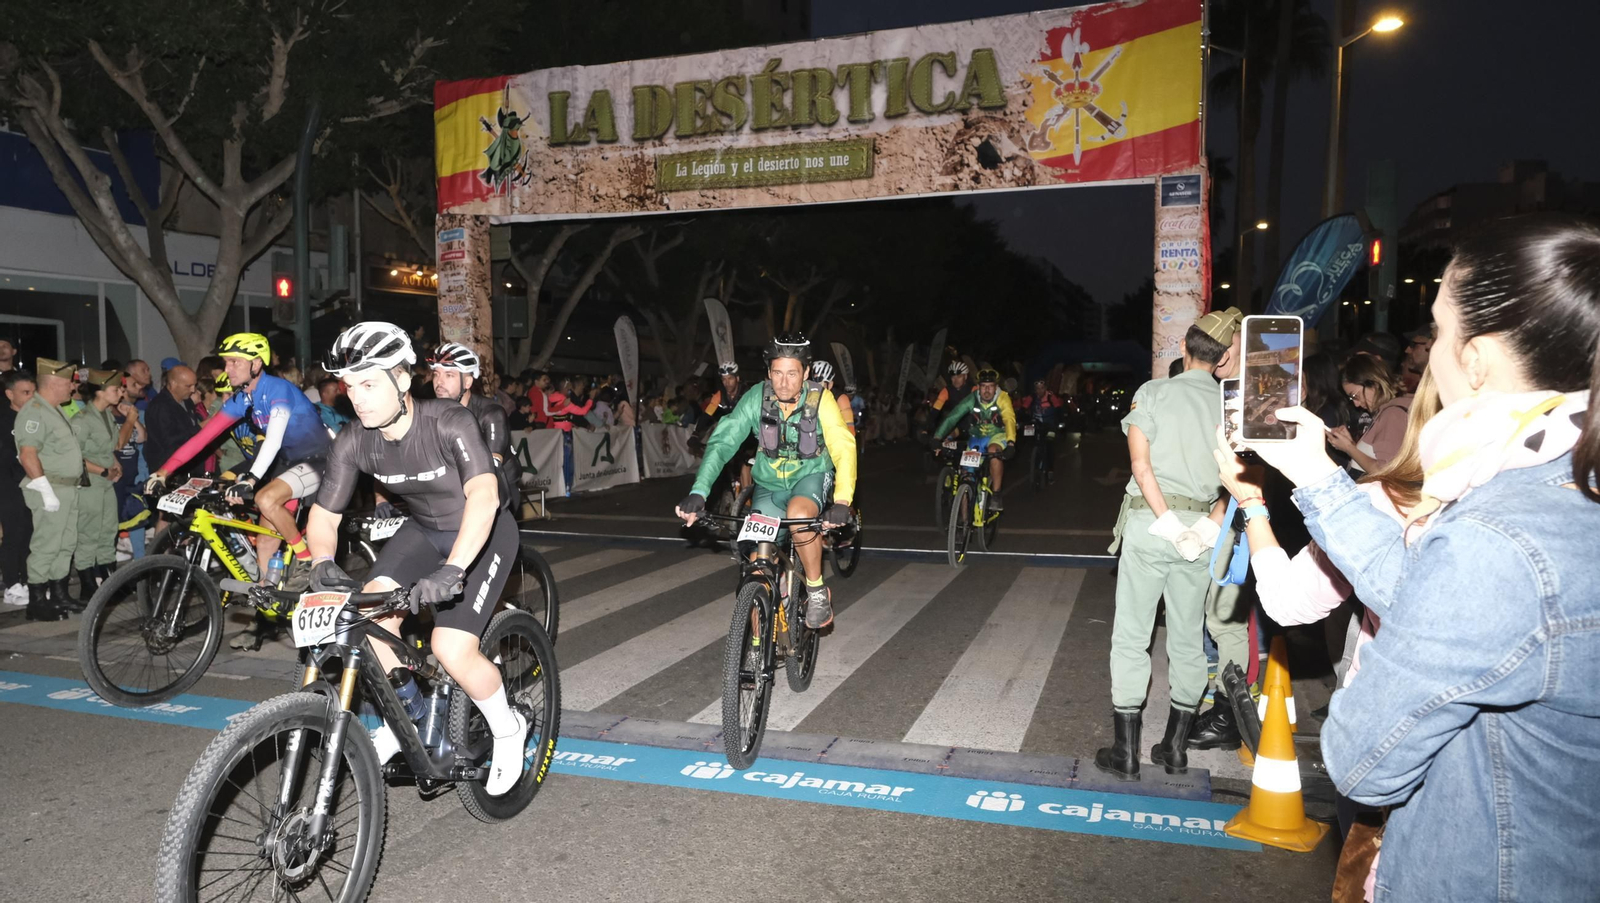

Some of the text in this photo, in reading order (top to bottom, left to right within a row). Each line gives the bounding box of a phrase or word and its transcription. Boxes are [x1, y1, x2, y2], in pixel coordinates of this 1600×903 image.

[548, 48, 1008, 145] LA DESÉRTICA
[675, 154, 850, 178] La Legión y el desierto nos une
[1161, 248, 1198, 258] RENTA
[443, 305, 464, 313] BBVA
[745, 521, 775, 536] 8640
[298, 606, 335, 631] 6133
[536, 738, 554, 783] MAXXIS
[579, 763, 619, 772] RURAL
[743, 769, 915, 797] cajamar
[818, 788, 903, 803] CAJA RURAL
[1132, 823, 1174, 833] CAJA
